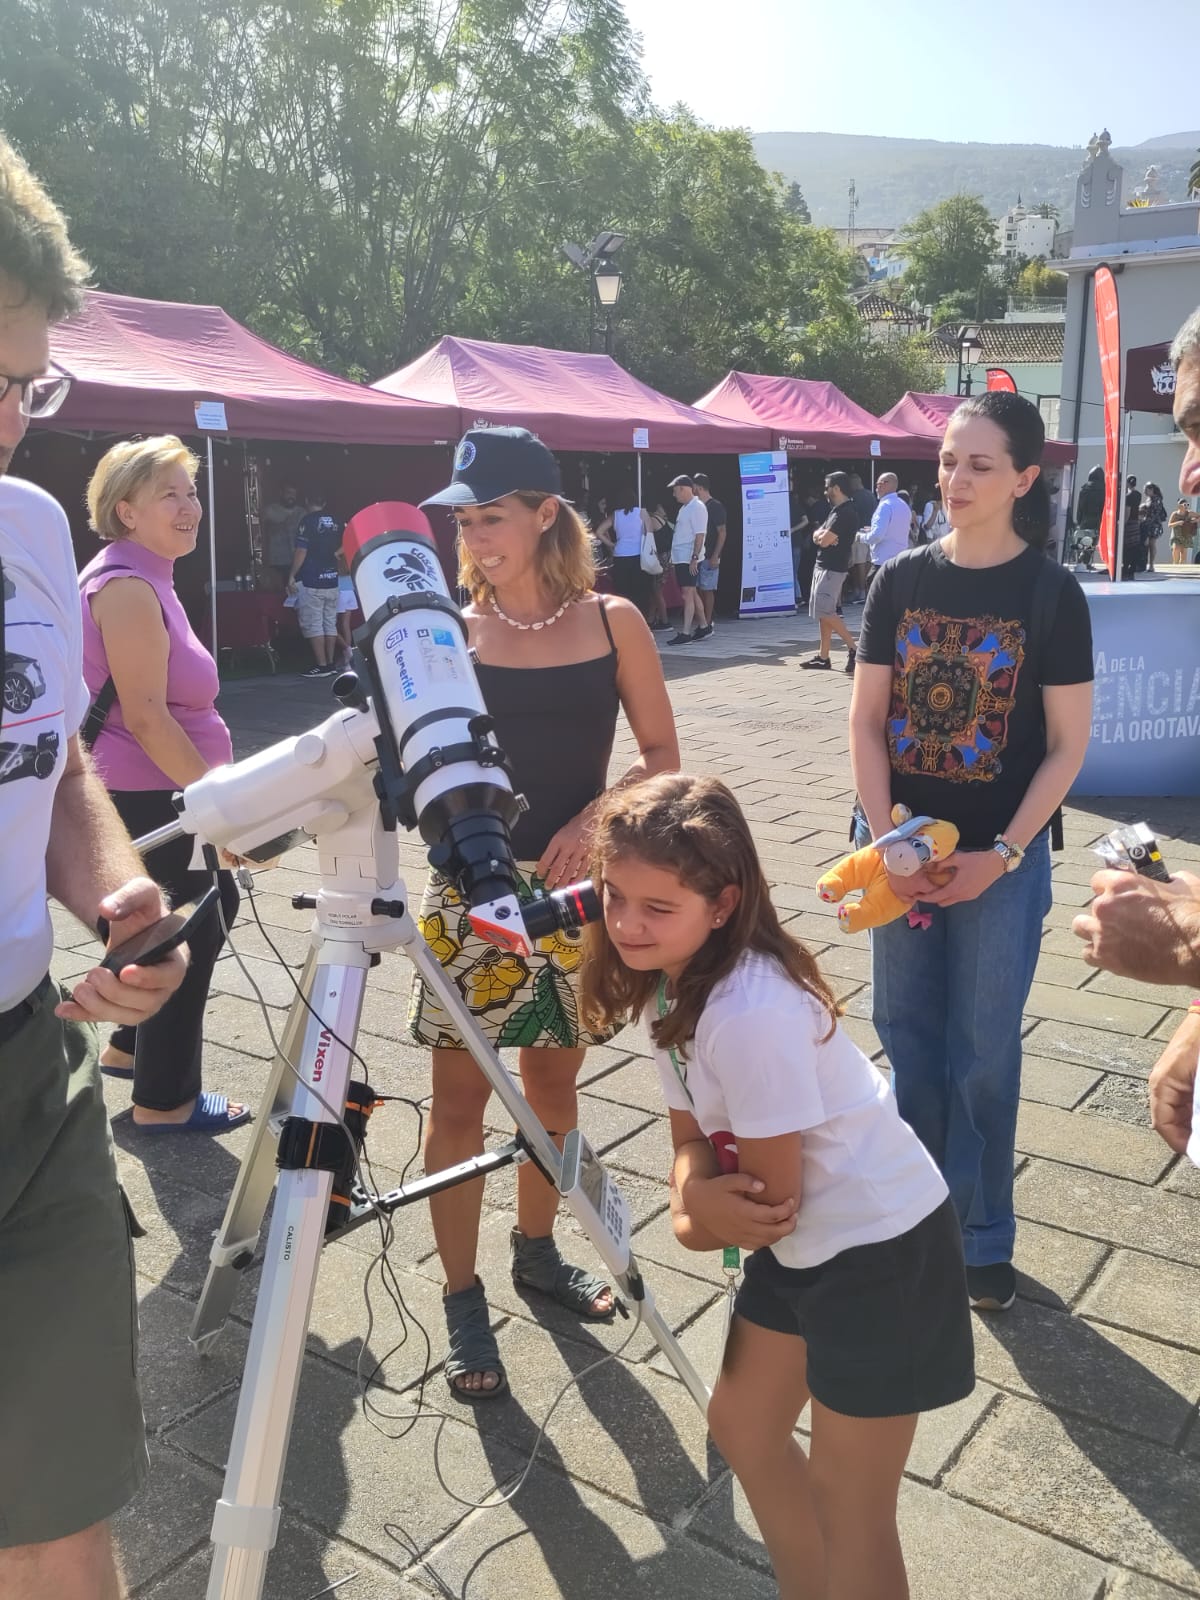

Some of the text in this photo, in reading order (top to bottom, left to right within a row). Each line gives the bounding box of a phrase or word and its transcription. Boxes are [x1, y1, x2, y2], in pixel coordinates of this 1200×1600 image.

[1110, 657, 1127, 673] DE
[1129, 655, 1145, 671] LA
[1090, 723, 1100, 738] E
[1102, 722, 1125, 743] LA
[312, 1029, 332, 1082] Vixen
[283, 1225, 294, 1261] CALISTO
